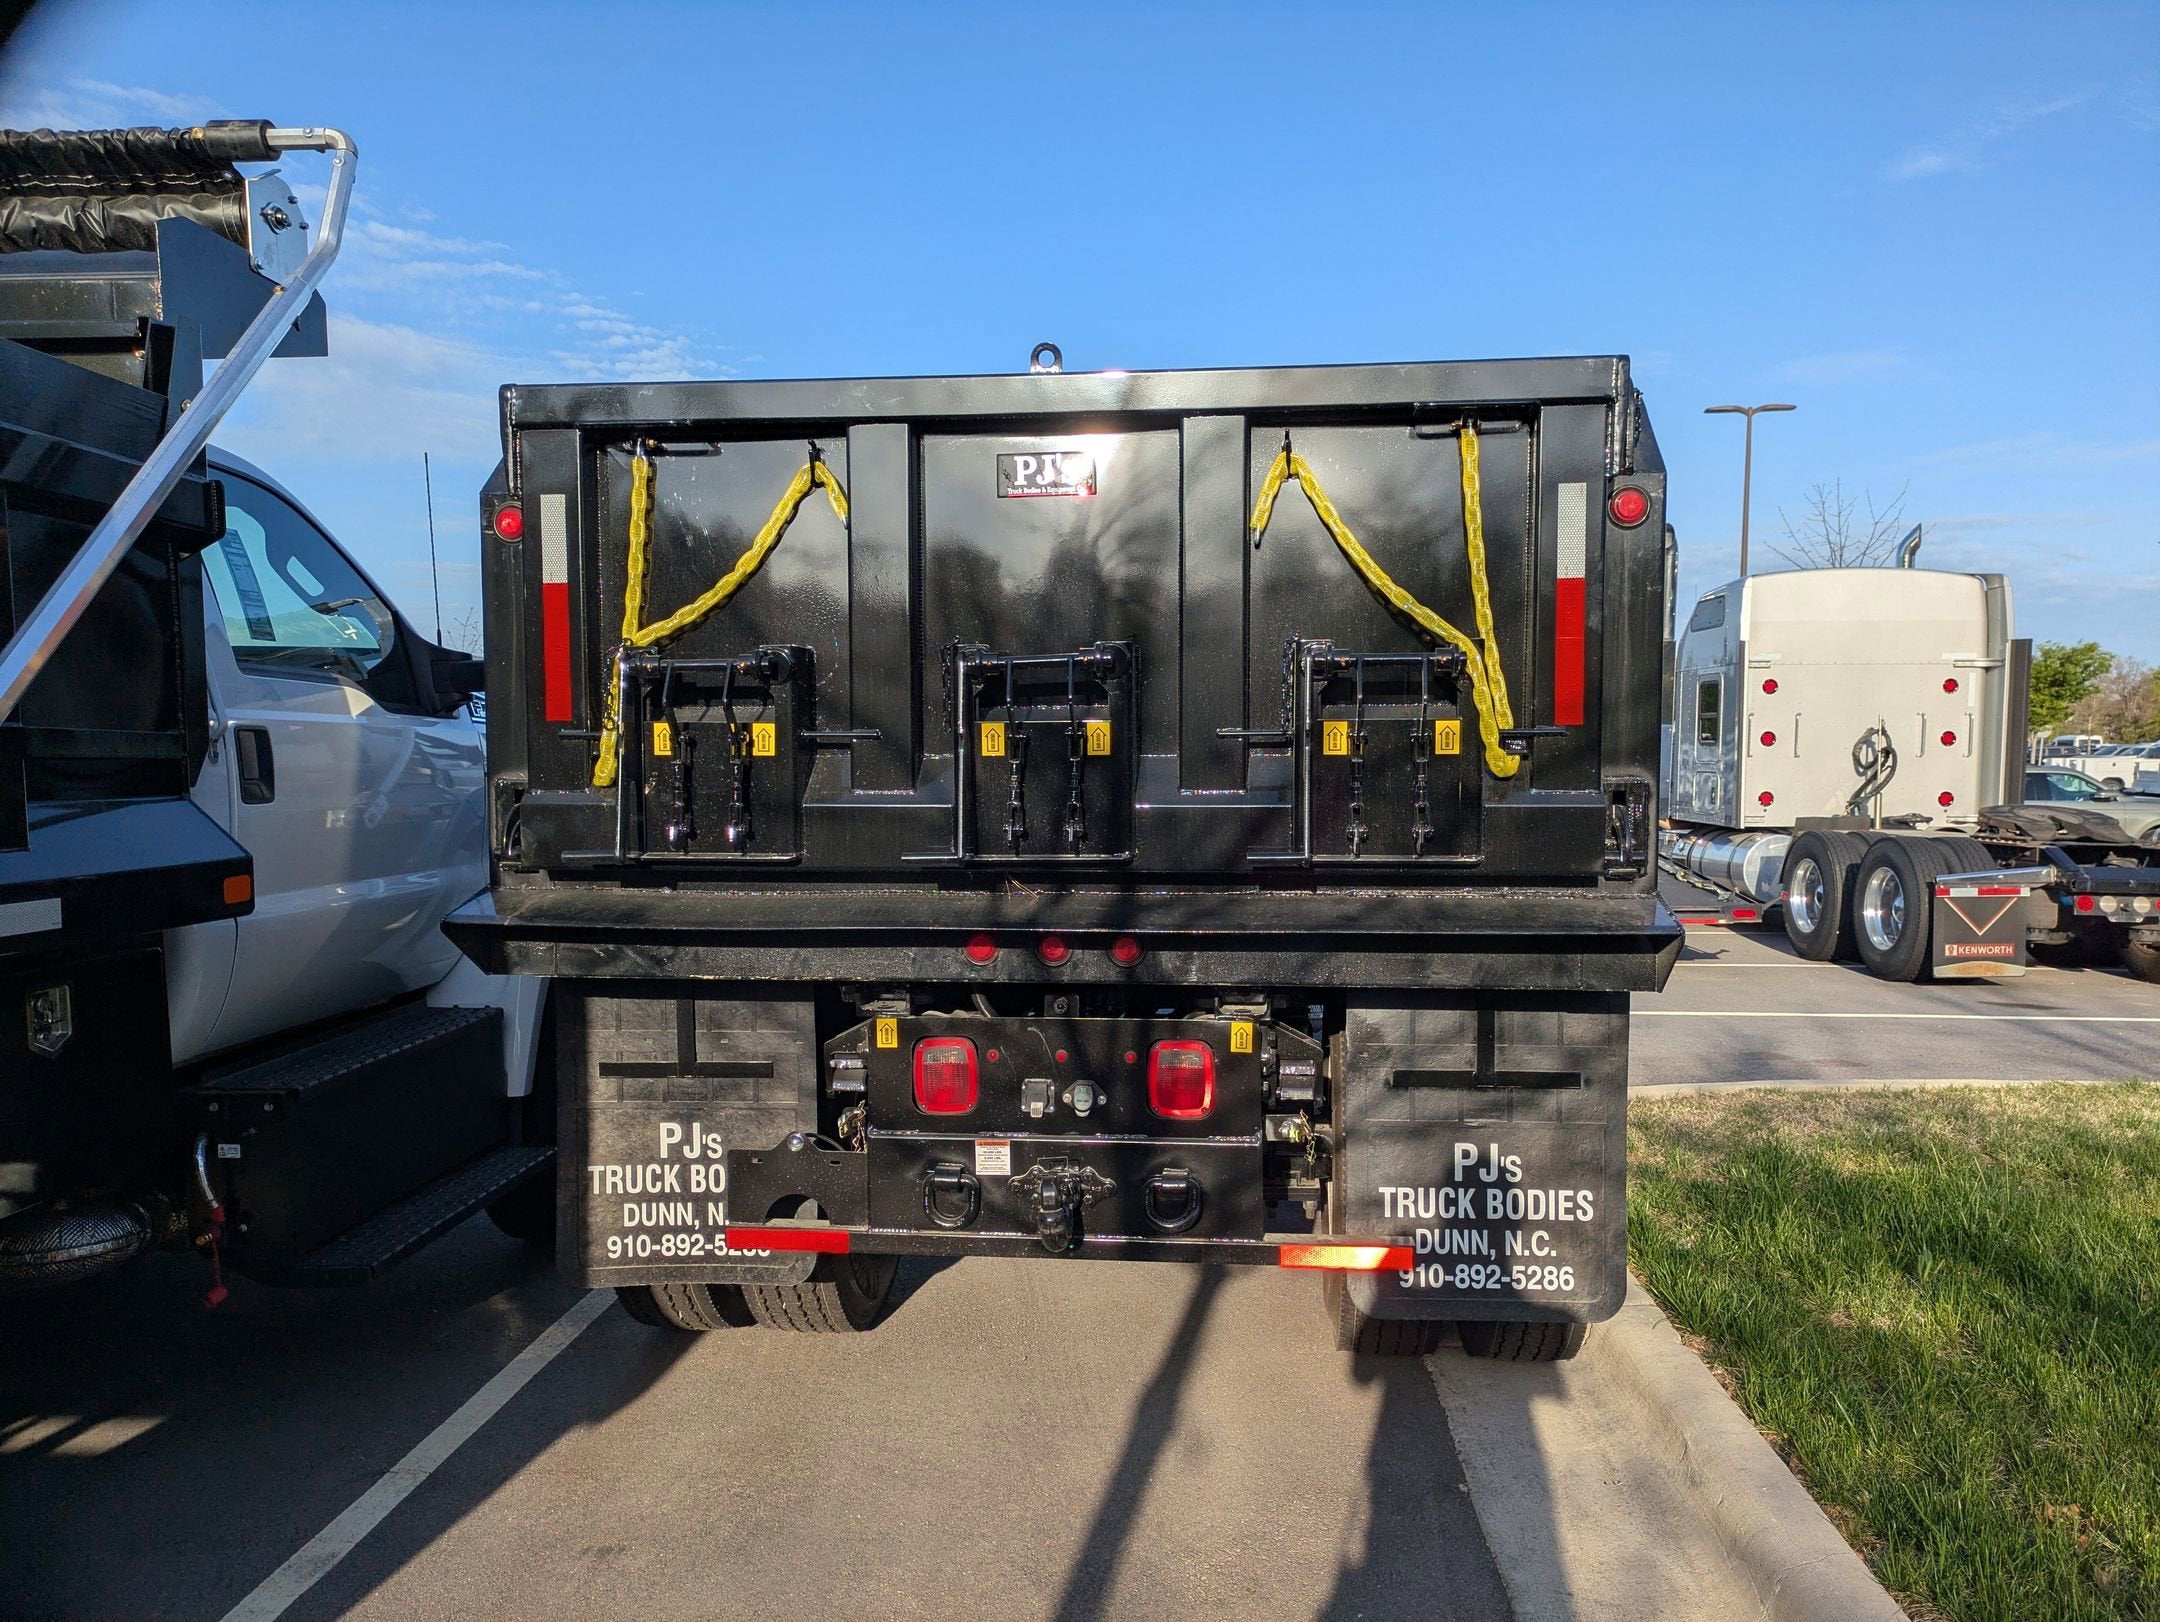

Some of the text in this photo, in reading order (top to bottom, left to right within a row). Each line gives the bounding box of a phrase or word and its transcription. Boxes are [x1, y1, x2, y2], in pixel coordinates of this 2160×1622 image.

[1958, 945, 2013, 954] KENWORTH
[659, 1122, 723, 1159] PJ's
[1454, 1142, 1523, 1183] PJ's
[588, 1164, 681, 1195] TRUCK
[623, 1202, 700, 1230] DUNN,
[1378, 1186, 1594, 1222] TRUCK BODIES
[1415, 1228, 1557, 1260] DUNN, N.C.
[1399, 1263, 1575, 1291] 910-892-5286
